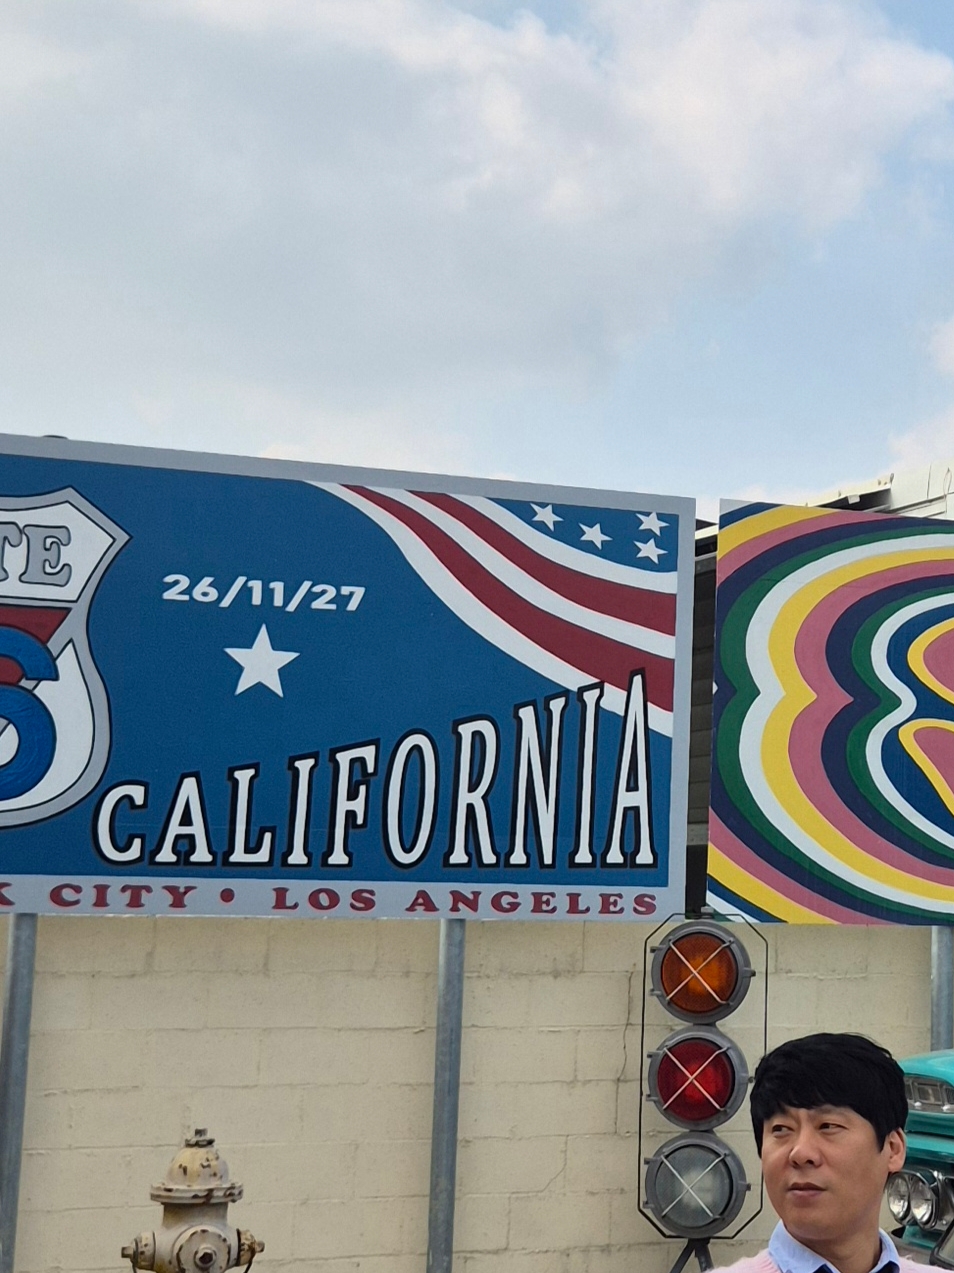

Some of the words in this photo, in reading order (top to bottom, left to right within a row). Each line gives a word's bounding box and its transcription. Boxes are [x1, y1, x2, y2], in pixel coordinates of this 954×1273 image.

[162, 573, 366, 613] 26/11/27
[93, 668, 657, 868] CALIFORNIA
[49, 882, 198, 909] CITY
[271, 887, 376, 912] LOS
[408, 889, 659, 916] ANGELES
